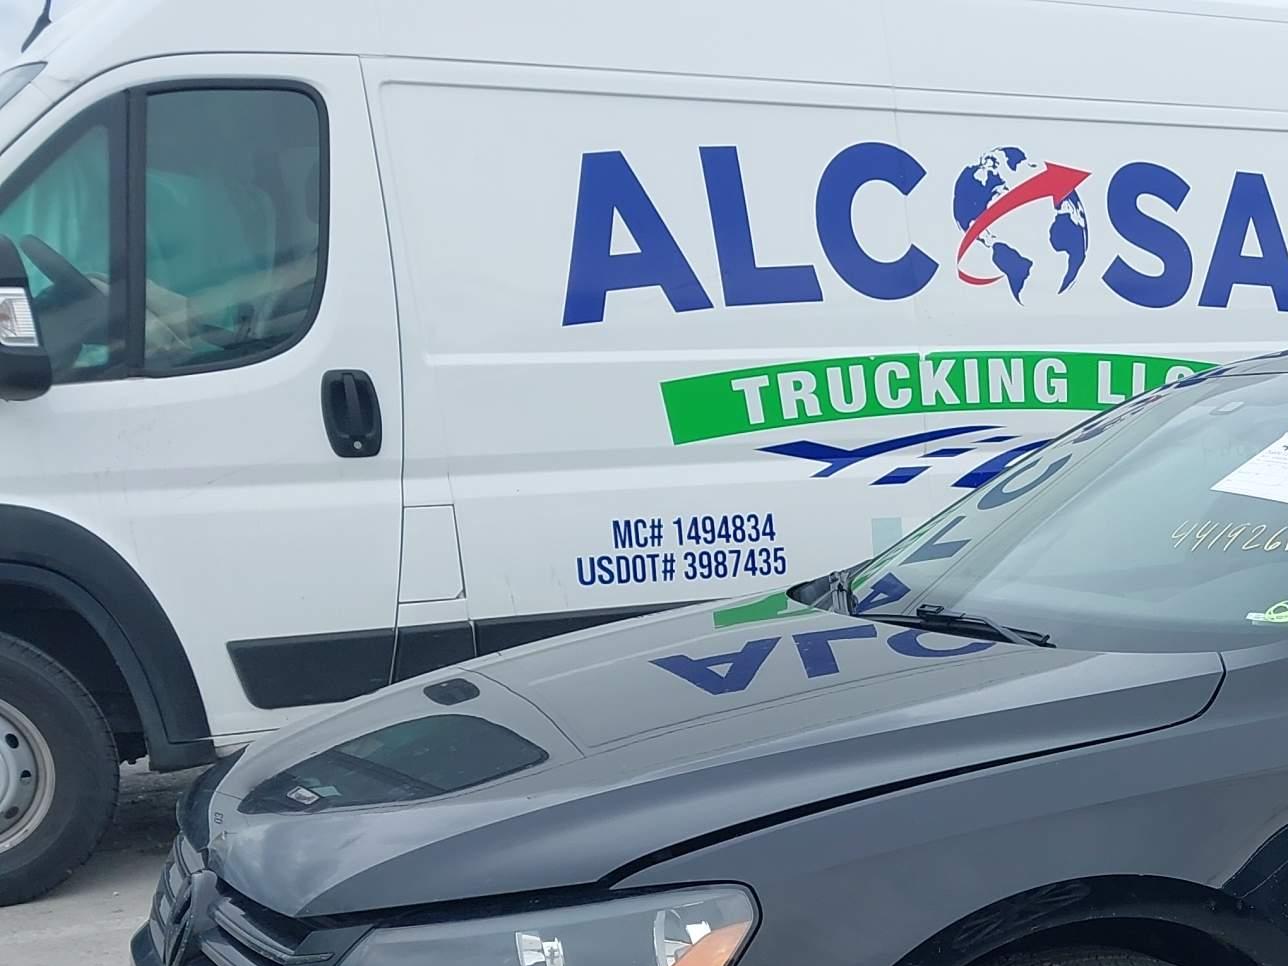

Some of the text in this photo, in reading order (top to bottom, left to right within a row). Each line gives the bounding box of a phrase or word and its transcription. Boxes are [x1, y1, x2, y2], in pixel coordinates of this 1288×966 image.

[731, 357, 1069, 425] TRUCKING
[612, 513, 776, 549] MC# 1494834
[576, 546, 787, 586] USDOT# 3987435
